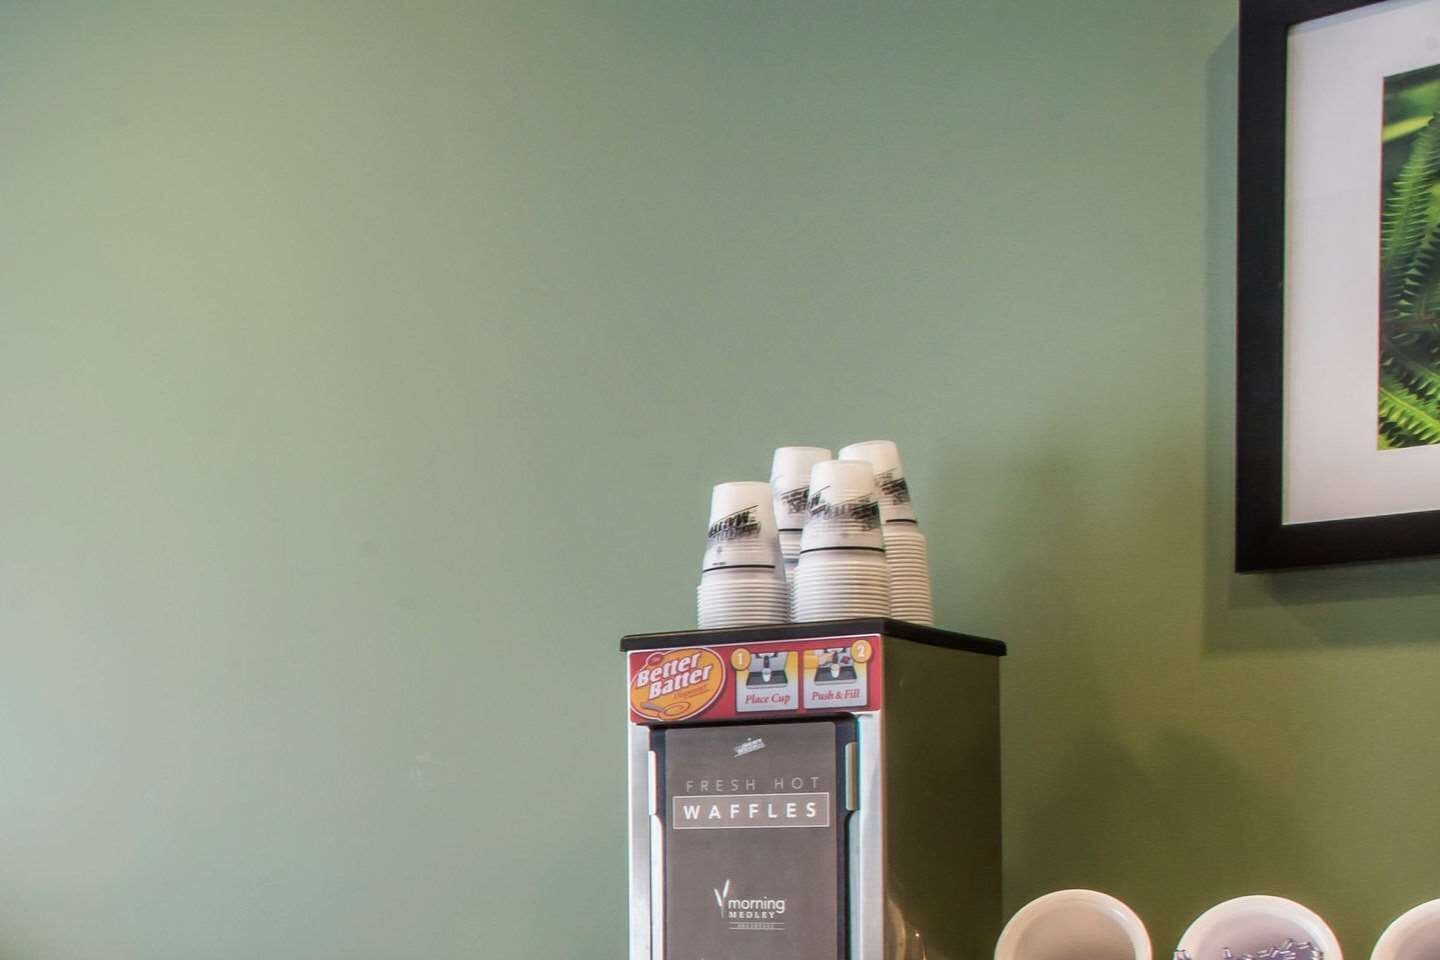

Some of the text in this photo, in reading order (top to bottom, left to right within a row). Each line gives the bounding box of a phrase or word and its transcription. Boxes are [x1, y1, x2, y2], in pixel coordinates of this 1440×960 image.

[637, 653, 702, 688] Better
[648, 665, 712, 699] Batter
[745, 693, 791, 705] Place Cup
[811, 688, 860, 701] Push & Fill
[686, 776, 820, 793] FRESH HOT
[683, 802, 817, 820] WAFFLES
[728, 896, 785, 914] morning
[728, 911, 776, 919] MEDLEY
